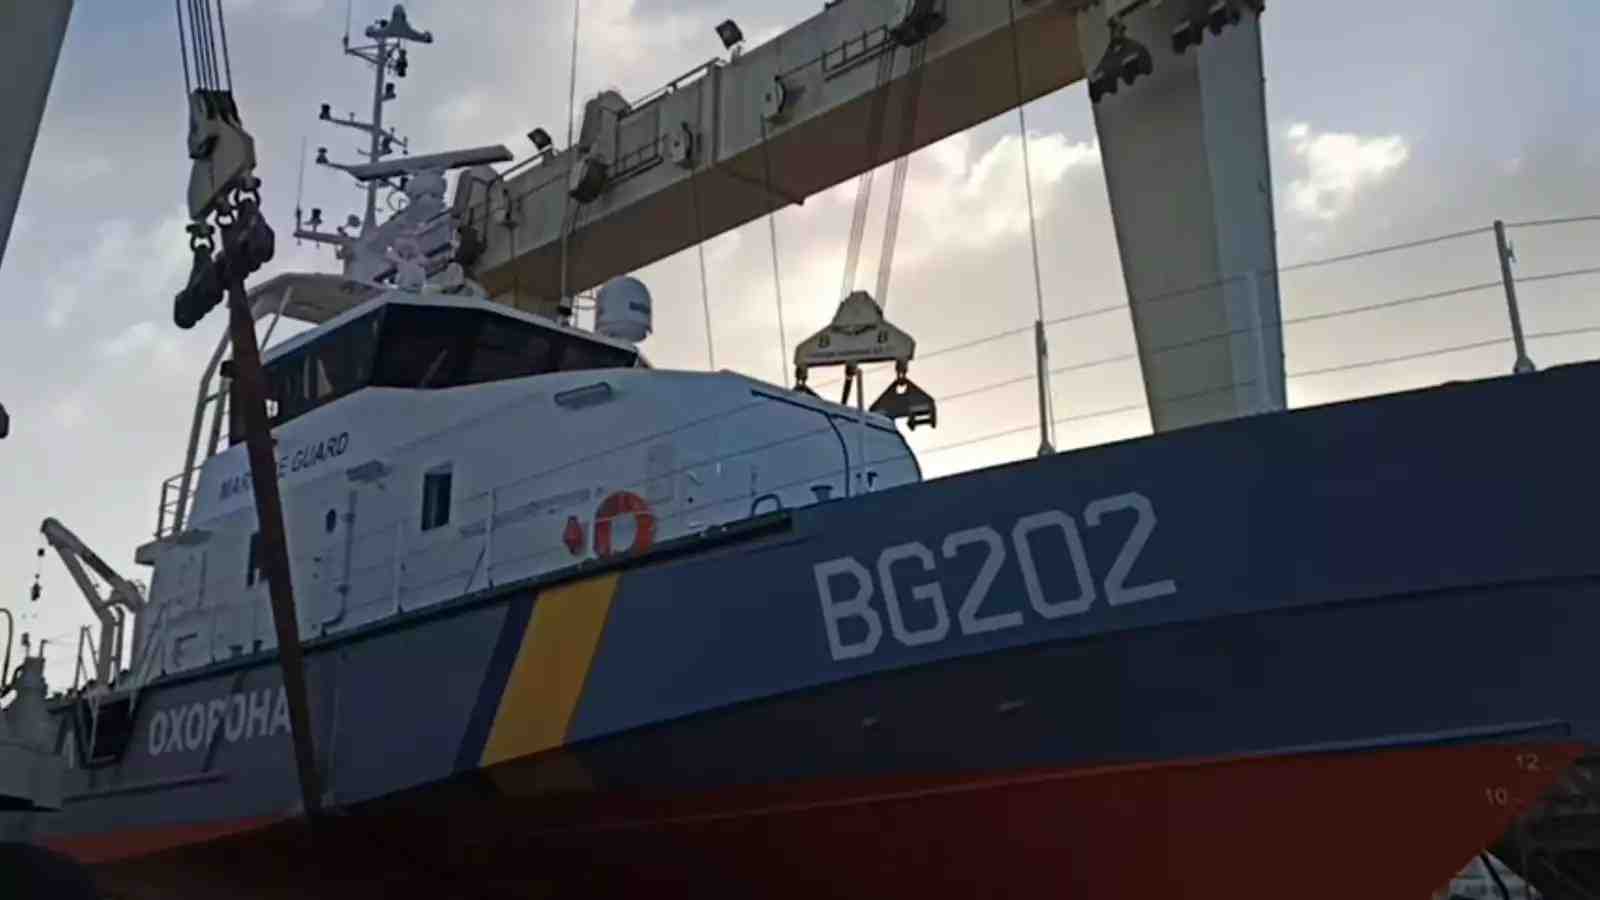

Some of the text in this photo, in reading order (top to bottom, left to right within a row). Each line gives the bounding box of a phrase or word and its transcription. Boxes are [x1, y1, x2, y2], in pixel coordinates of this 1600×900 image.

[219, 431, 349, 500] MARE GUARD
[813, 492, 1177, 661] BG202
[1515, 753, 1541, 771] 12
[1485, 786, 1509, 806] 10
